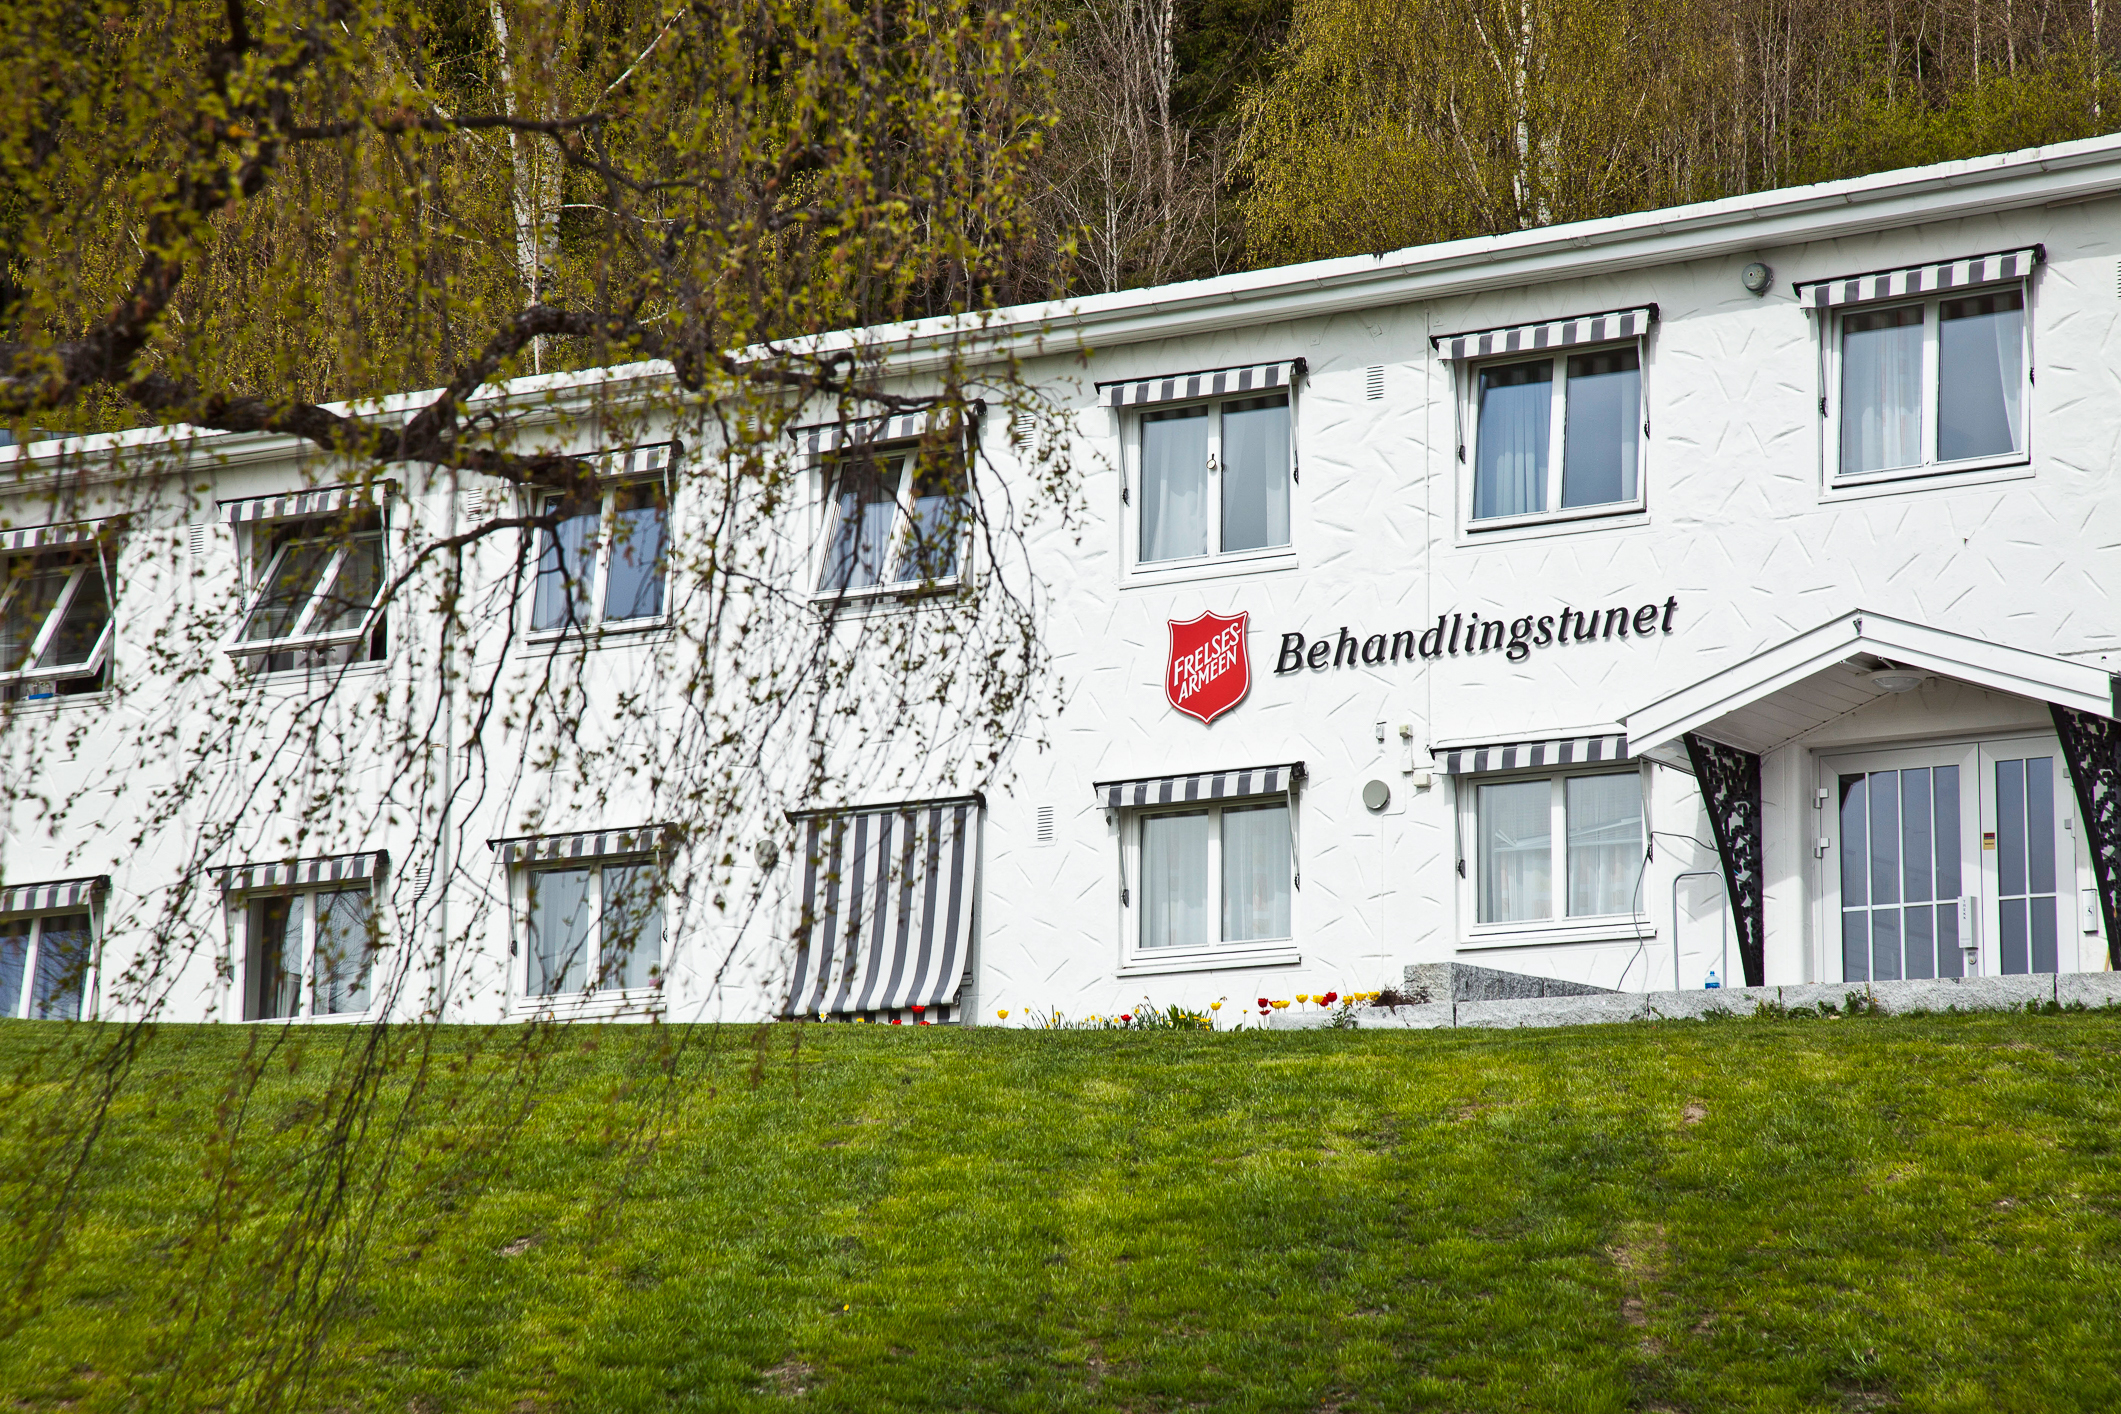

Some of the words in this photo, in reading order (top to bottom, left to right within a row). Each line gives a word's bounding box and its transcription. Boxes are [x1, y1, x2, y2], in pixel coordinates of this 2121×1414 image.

[1173, 622, 1241, 687] FRELSES-
[1273, 595, 1678, 674] Behandlingstunet
[1178, 645, 1237, 704] ARMEEN
